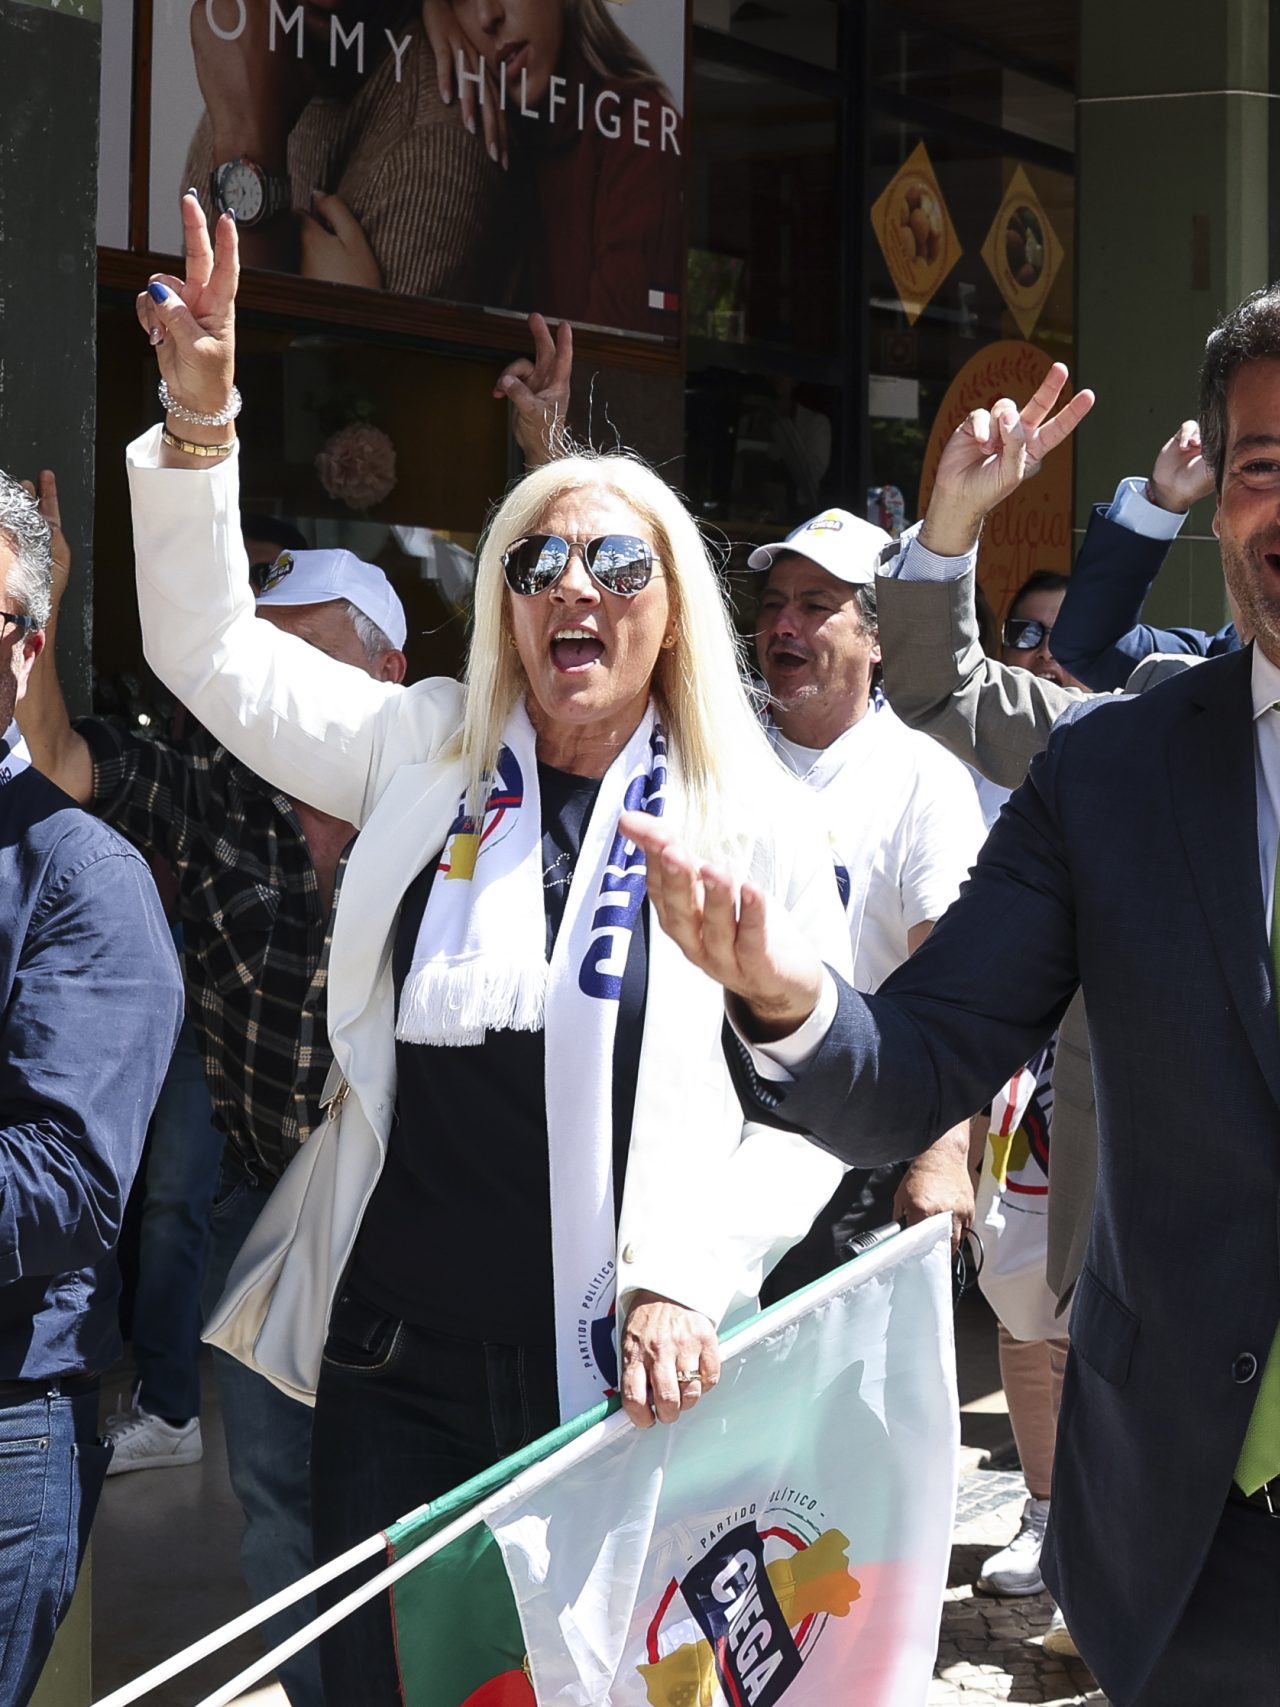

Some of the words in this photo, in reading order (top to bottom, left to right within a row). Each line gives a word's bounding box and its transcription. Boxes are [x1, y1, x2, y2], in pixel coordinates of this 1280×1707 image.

[457, 49, 682, 156] HILFIGER
[581, 1260, 614, 1309] POLÍTICO
[577, 1318, 593, 1368] PARTIDO
[700, 1503, 756, 1548] PARTIDO
[770, 1487, 817, 1510] LÍTICO
